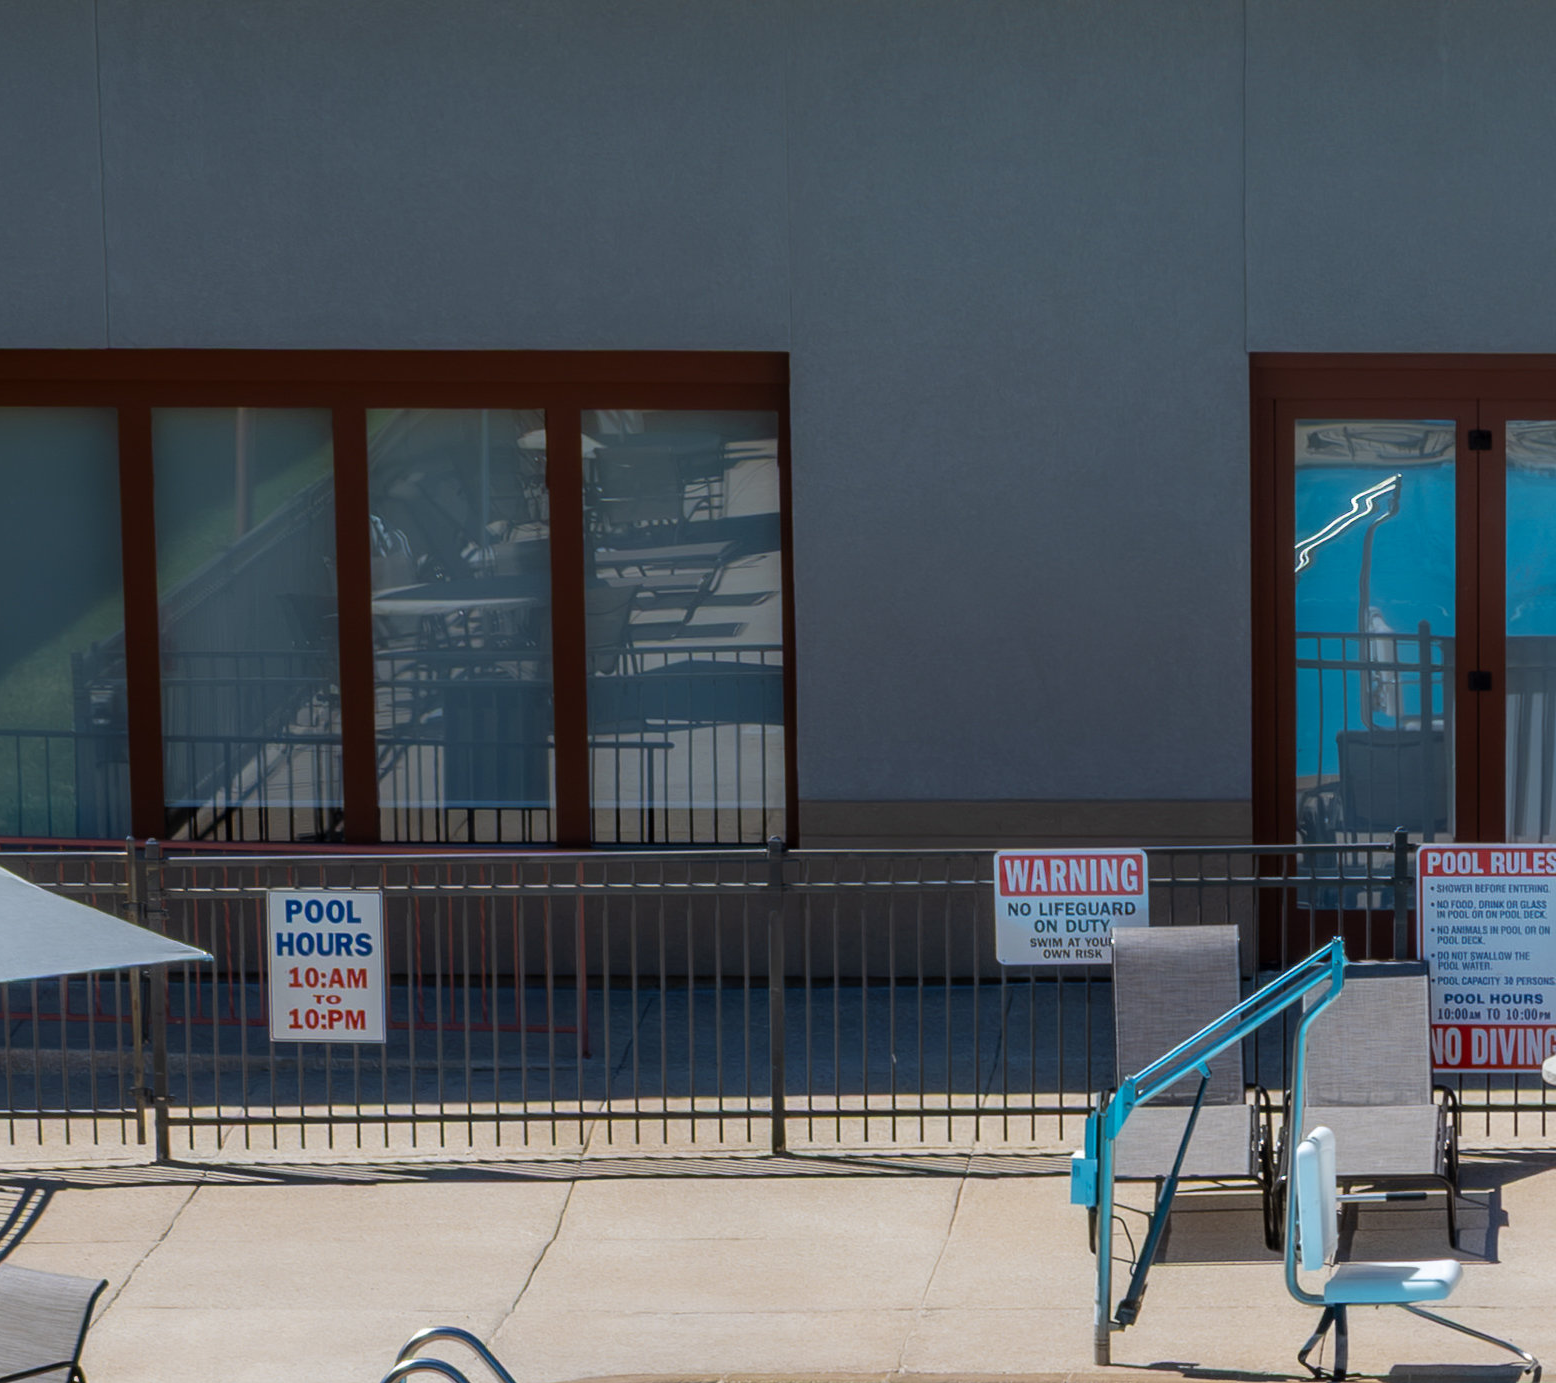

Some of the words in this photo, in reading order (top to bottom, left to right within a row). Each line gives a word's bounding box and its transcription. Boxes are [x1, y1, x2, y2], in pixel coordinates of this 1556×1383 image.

[1427, 851, 1484, 874] POOL
[1004, 857, 1139, 892] WARNING
[1436, 884, 1473, 894] SHOWER
[1475, 884, 1506, 894] BEFORE
[1008, 902, 1031, 916] NO
[1039, 901, 1136, 916] LIFEGUARD
[1437, 900, 1449, 909] NO
[1478, 900, 1505, 909] DRINK
[1506, 900, 1518, 909] OR
[1520, 900, 1547, 909] GLASS
[285, 899, 362, 924] POOL
[1437, 910, 1445, 919] IN
[1448, 910, 1469, 919] POOL
[1472, 910, 1483, 919] OR
[1486, 910, 1497, 919] ON
[1500, 910, 1521, 919] POOL
[1034, 919, 1057, 933] ON
[1066, 919, 1110, 933] DUTY
[1437, 926, 1449, 935] NO
[1451, 926, 1488, 935] ANIMALS
[1490, 926, 1498, 935] IN
[1501, 926, 1522, 935] POOL
[1525, 926, 1536, 935] OR
[1539, 926, 1551, 935] ON
[276, 932, 373, 957] HOURS
[1030, 937, 1062, 948] SWIM
[1068, 937, 1081, 947] AT
[1437, 936, 1459, 945] POOL
[1461, 936, 1485, 945] DECK.
[1043, 949, 1070, 959] OWN
[1075, 948, 1103, 959] RISK
[1437, 951, 1449, 961] DO
[1452, 951, 1467, 961] NOT
[1470, 951, 1513, 961] SWALLOW
[1515, 951, 1530, 961] THE
[1438, 962, 1459, 971] POOL
[1462, 962, 1493, 971] WATER.
[288, 967, 368, 989] 10:AM
[1437, 977, 1459, 986] POOL
[1461, 977, 1501, 986] CAPACITY
[313, 994, 342, 1005] TO
[1444, 993, 1485, 1004] POOL
[1490, 993, 1544, 1004] HOURS
[288, 1008, 366, 1031] 10:PM
[1487, 1008, 1500, 1020] TO
[1431, 1027, 1462, 1066] NO
